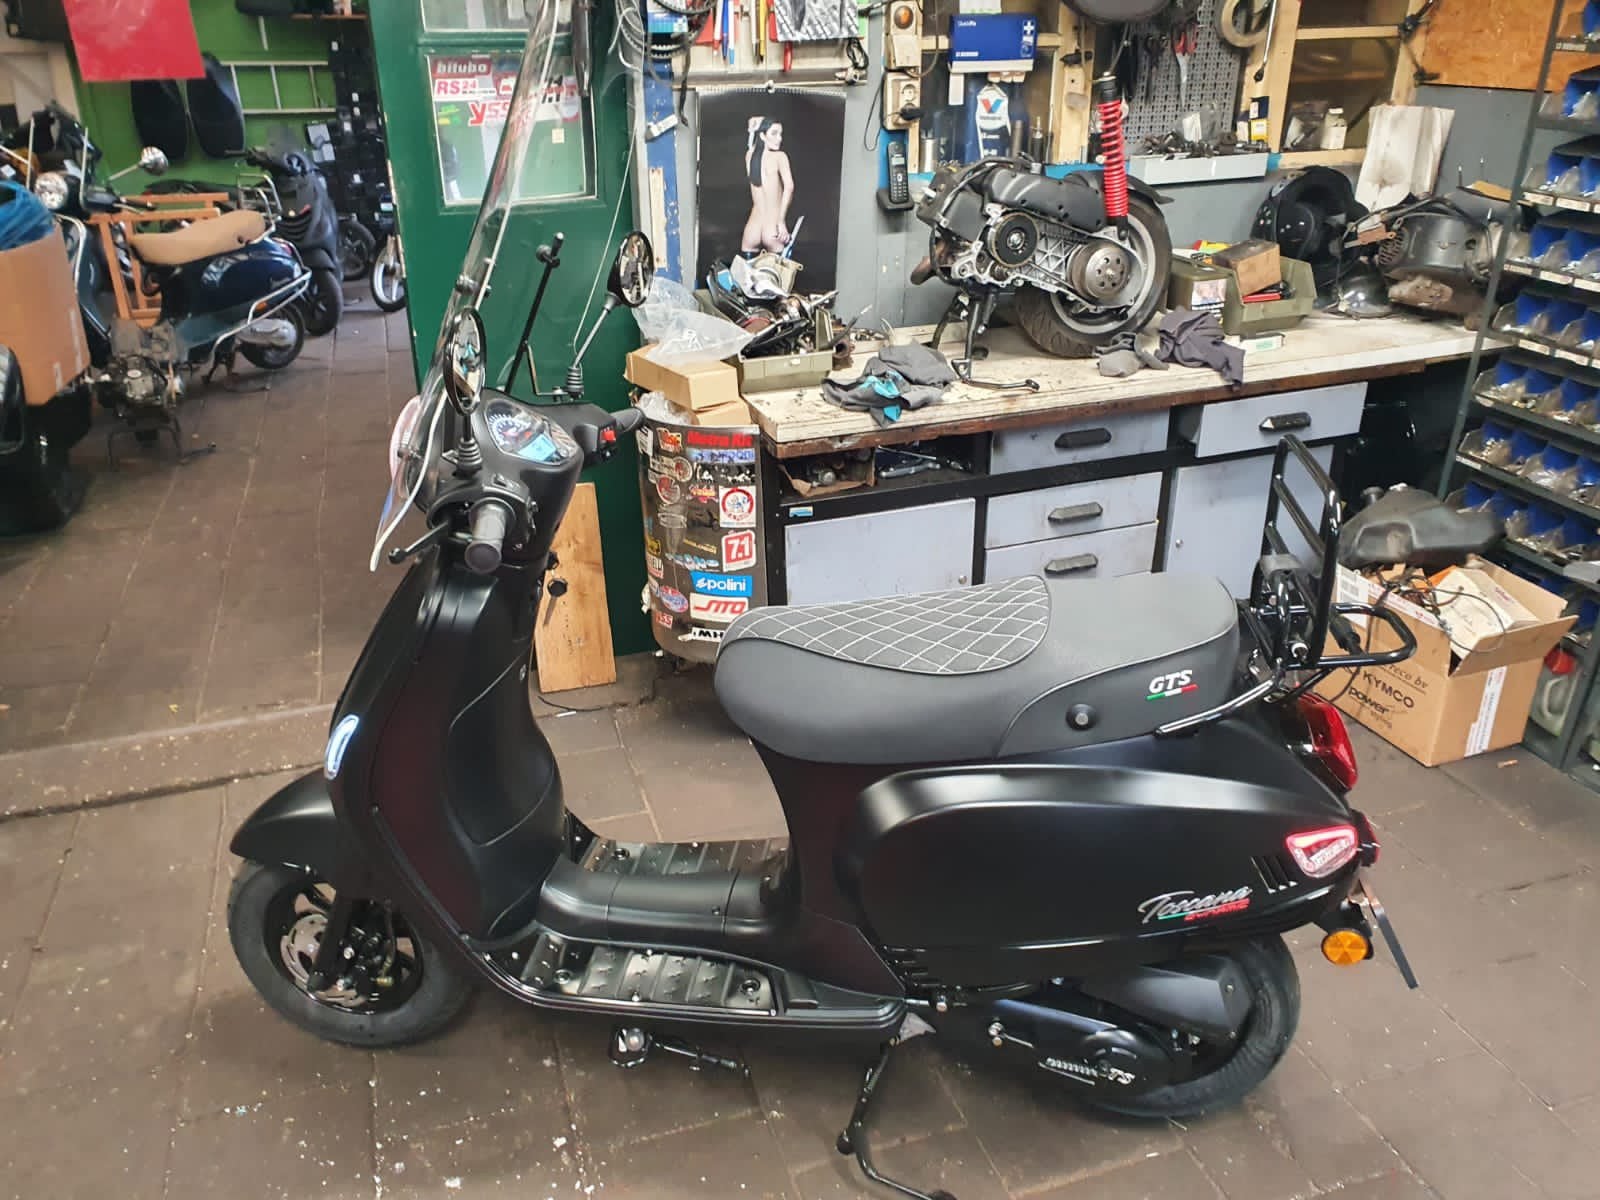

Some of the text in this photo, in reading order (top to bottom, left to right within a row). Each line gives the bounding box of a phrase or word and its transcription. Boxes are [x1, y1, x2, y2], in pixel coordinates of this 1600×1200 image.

[437, 61, 487, 74] bitubo
[727, 535, 751, 560] 7.1
[706, 578, 746, 594] polini
[1149, 669, 1193, 694] GTS
[1362, 669, 1415, 709] KYMCO
[1347, 686, 1391, 715] power
[1137, 885, 1254, 925] Toscana
